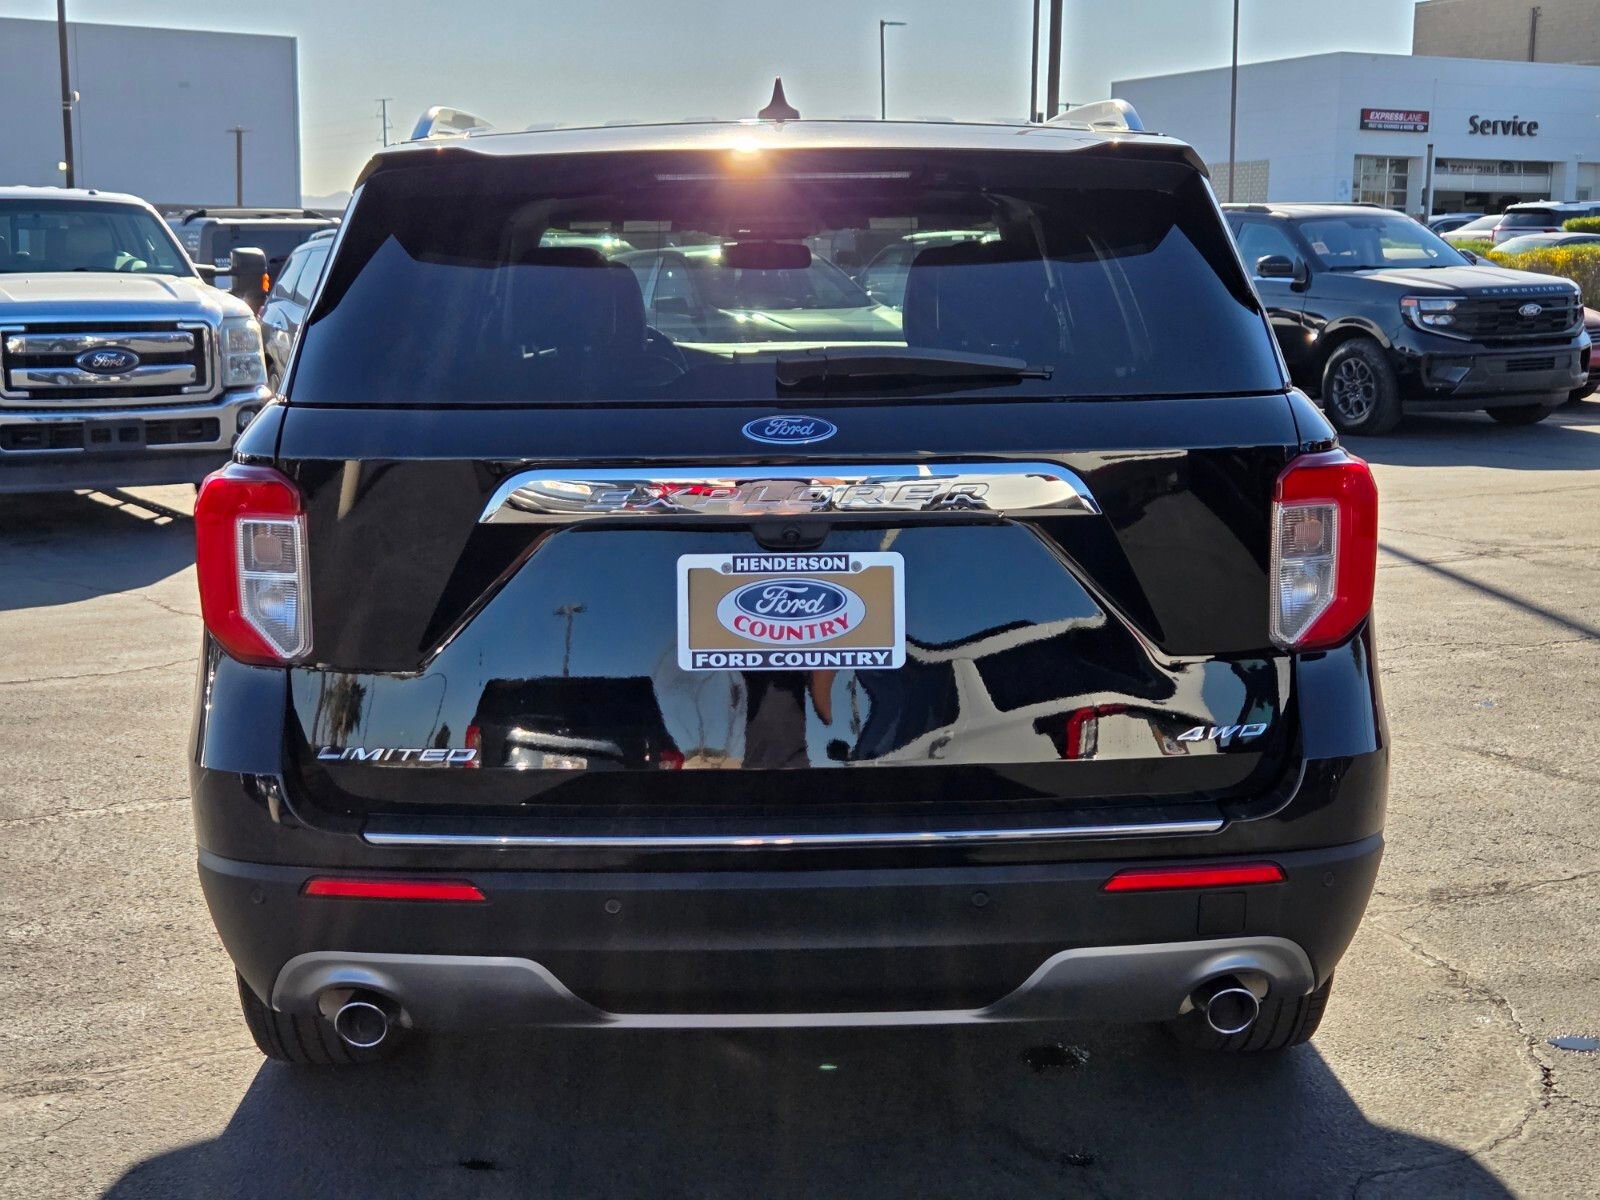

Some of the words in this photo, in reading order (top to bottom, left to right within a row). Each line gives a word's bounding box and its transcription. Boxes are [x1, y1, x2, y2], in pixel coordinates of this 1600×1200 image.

[1469, 115, 1539, 137] Service
[92, 352, 126, 367] Ford
[764, 417, 815, 436] Ford
[583, 482, 990, 509] EXPLORER
[735, 556, 847, 572] HENDERSON
[755, 585, 825, 614] Ford
[733, 612, 850, 641] COUNTRY
[695, 653, 764, 668] FORD
[768, 650, 890, 667] COUNTRY
[1176, 722, 1268, 741] 4WD
[316, 746, 478, 762] LIMITED
